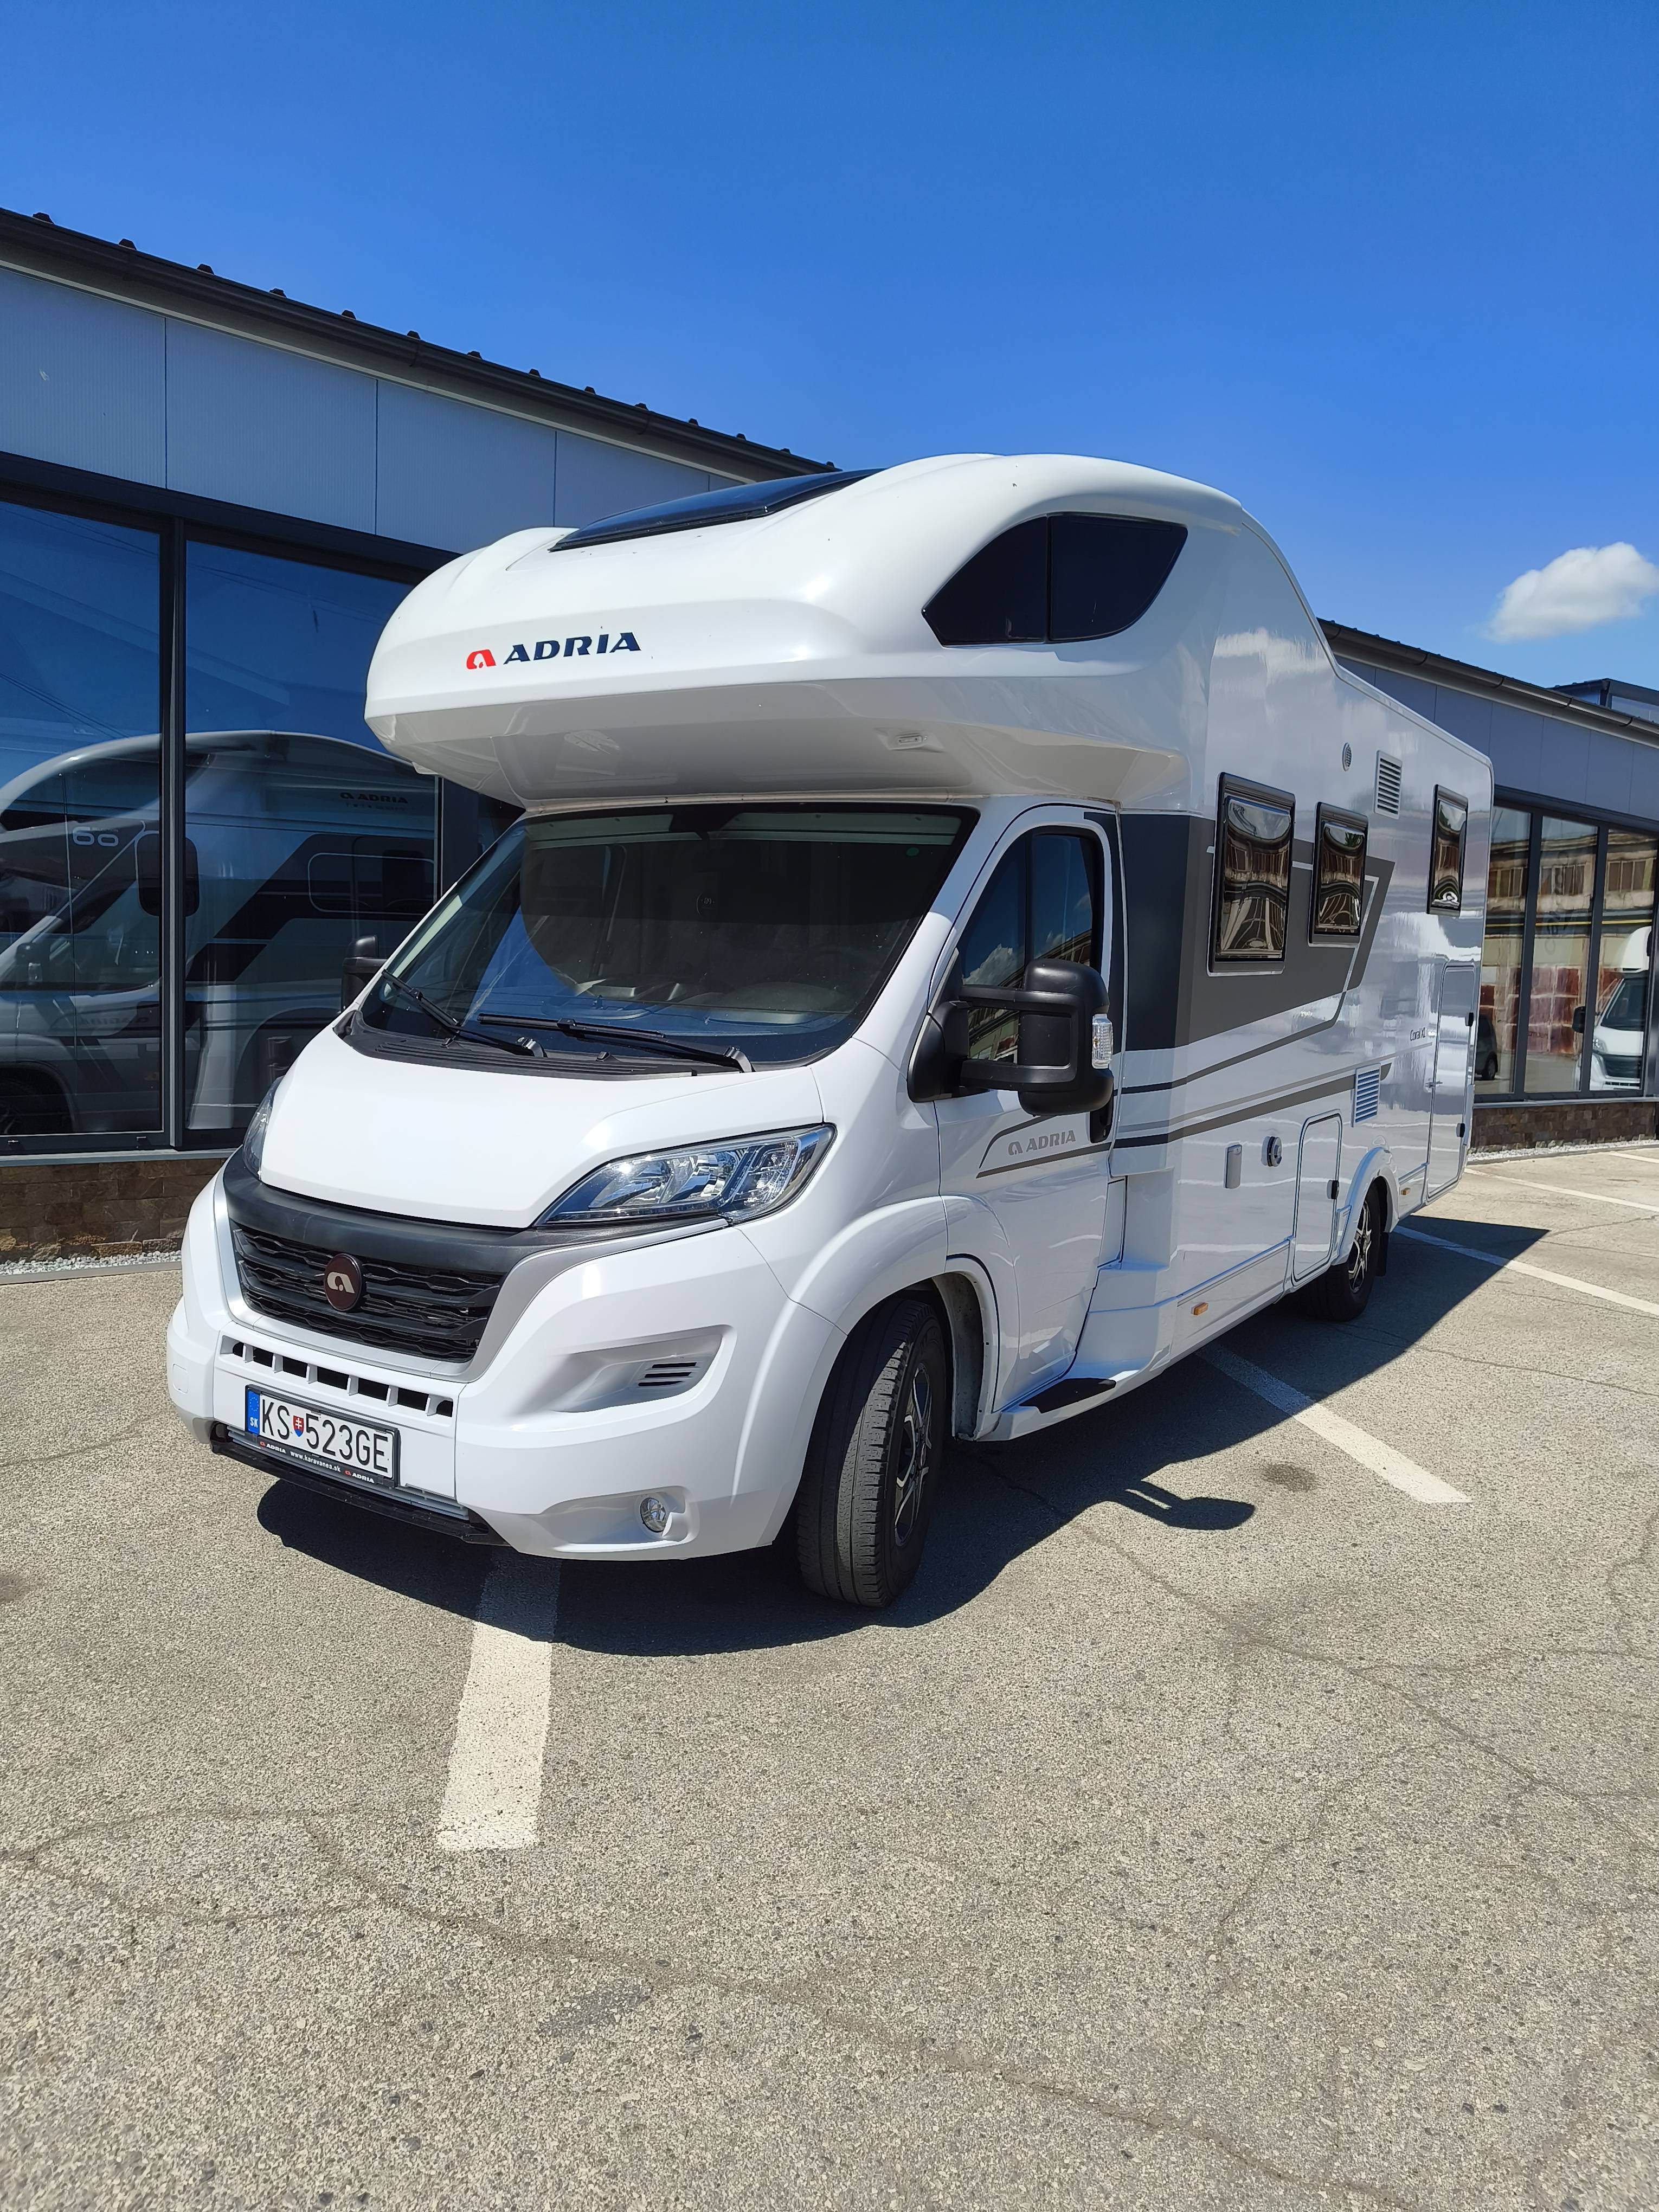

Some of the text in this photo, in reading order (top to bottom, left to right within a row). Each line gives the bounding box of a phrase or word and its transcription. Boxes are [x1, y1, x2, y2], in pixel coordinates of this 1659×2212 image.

[503, 632, 642, 665] ADRIA
[357, 793, 408, 804] ADRIA
[73, 826, 119, 847] 60
[1026, 1130, 1076, 1152] ADRIA
[250, 1417, 259, 1429] SK
[266, 1443, 375, 1483] ADRIA www.karavanea.sk ADRIA
